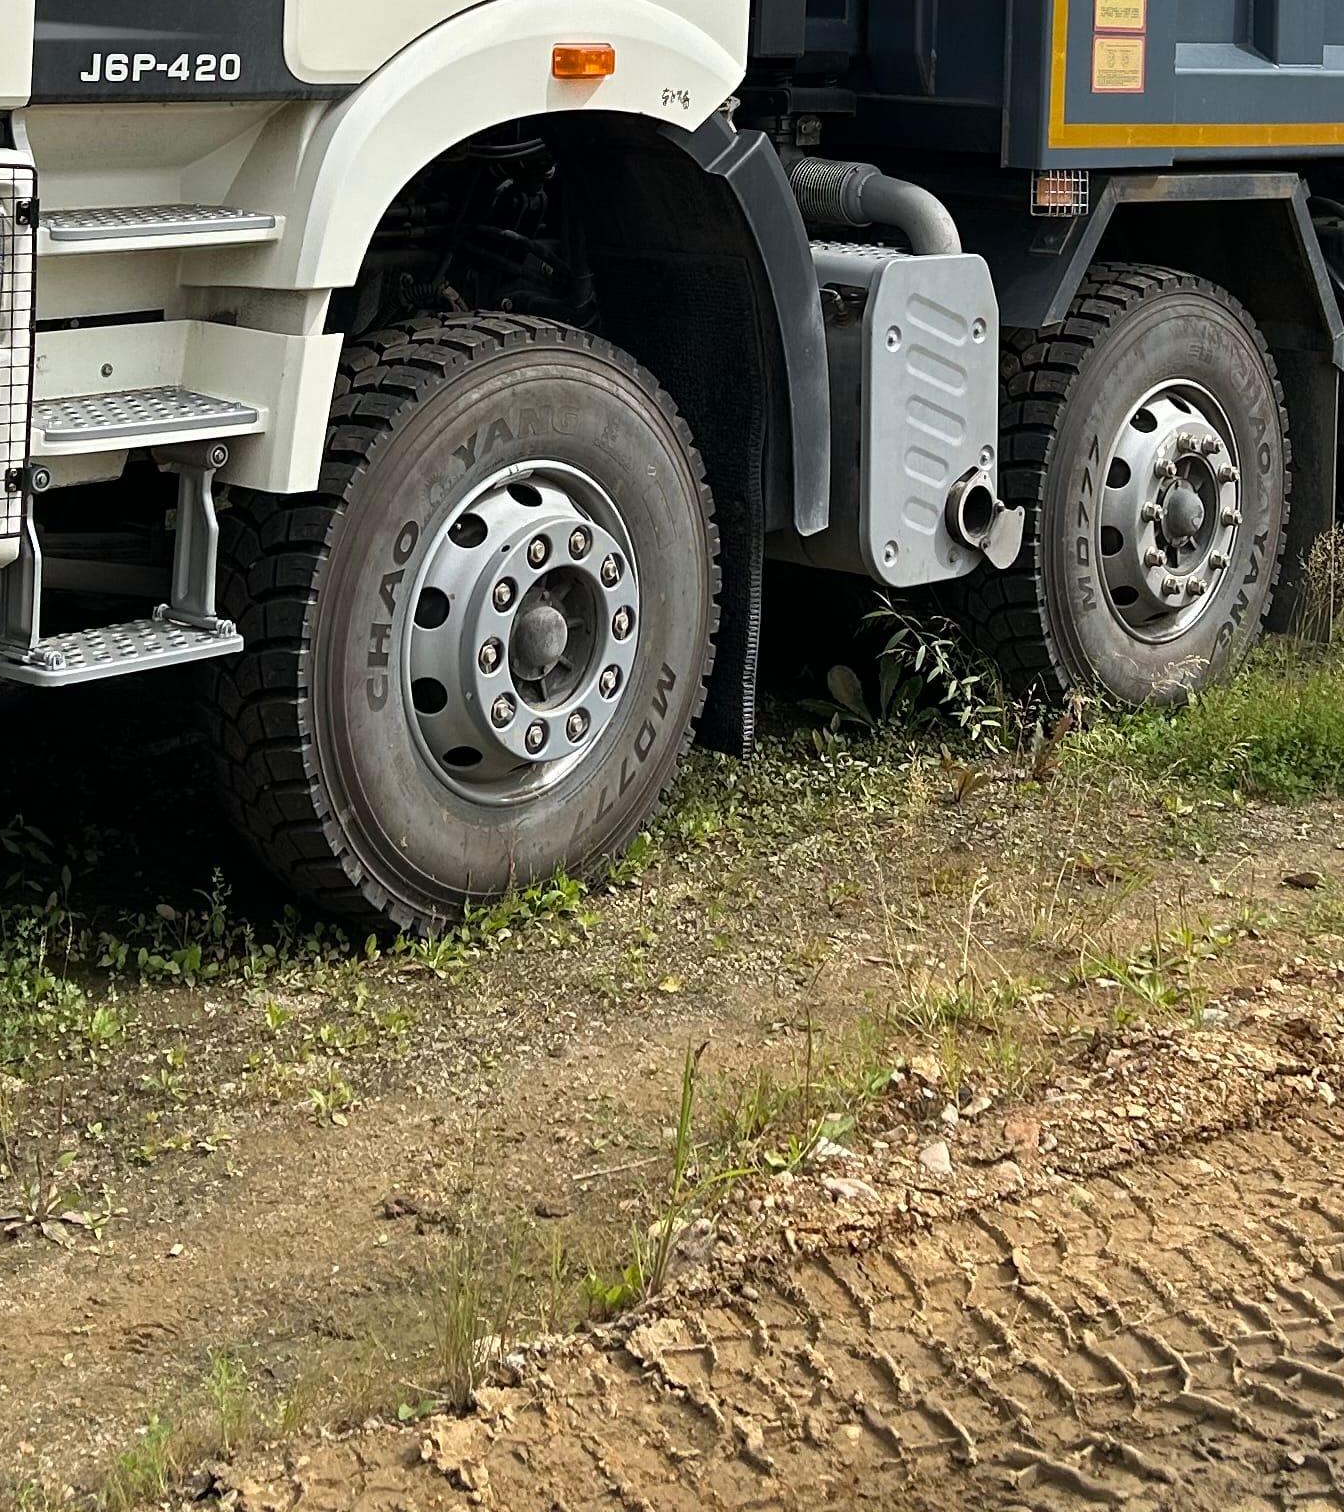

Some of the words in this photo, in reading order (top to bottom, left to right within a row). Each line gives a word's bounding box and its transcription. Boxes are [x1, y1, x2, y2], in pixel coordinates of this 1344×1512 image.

[80, 53, 241, 82] J6P-420
[366, 518, 420, 714] CHAO
[451, 404, 581, 471] YANG
